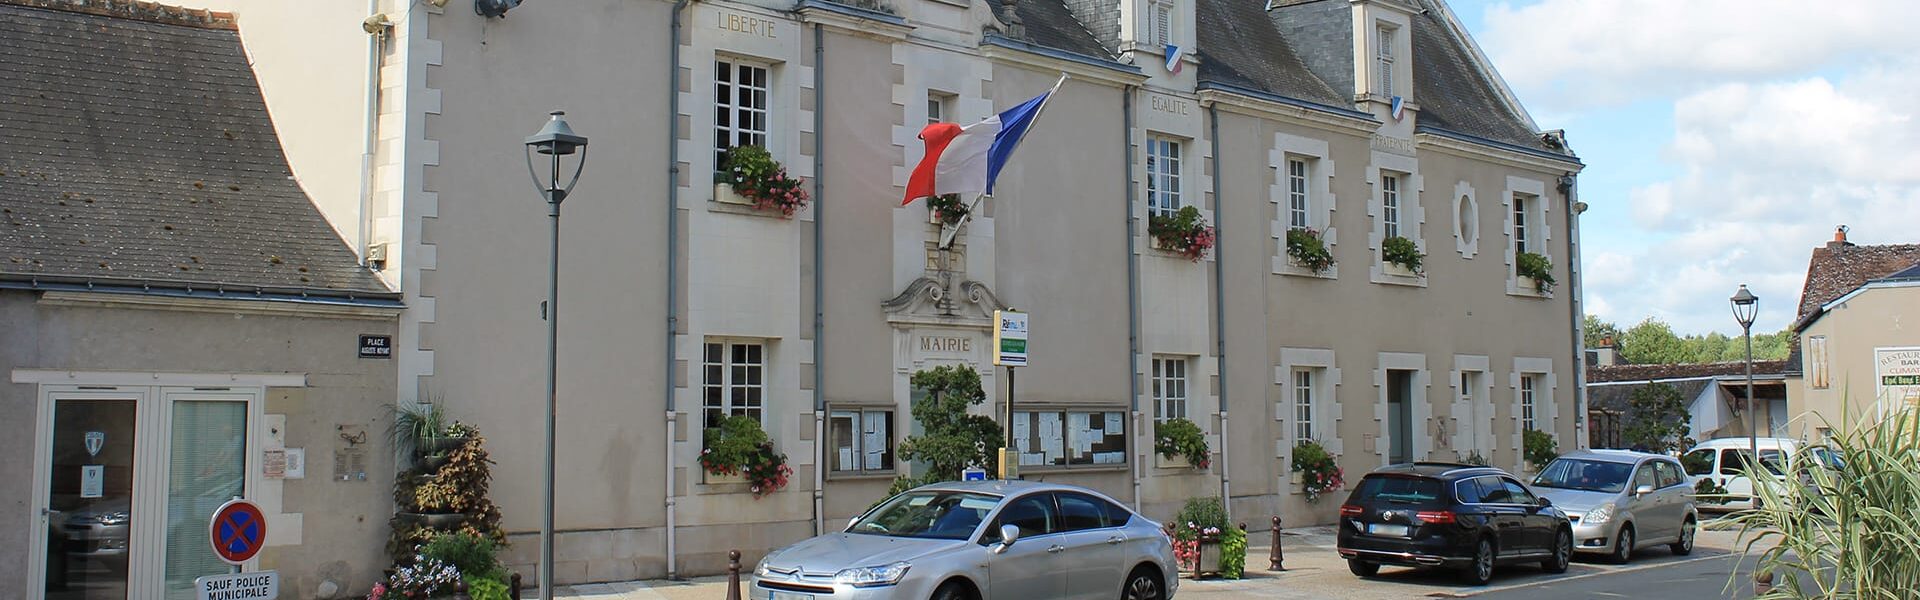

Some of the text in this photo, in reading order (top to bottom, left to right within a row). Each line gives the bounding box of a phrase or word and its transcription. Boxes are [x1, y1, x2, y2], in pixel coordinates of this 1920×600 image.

[718, 11, 776, 38] LIBERTE
[1152, 95, 1188, 115] EGALITE
[367, 338, 384, 346] PLACE
[920, 337, 970, 351] MAIRIE
[206, 575, 270, 591] SAUF POLICE
[208, 586, 268, 600] MUNICIPALE
